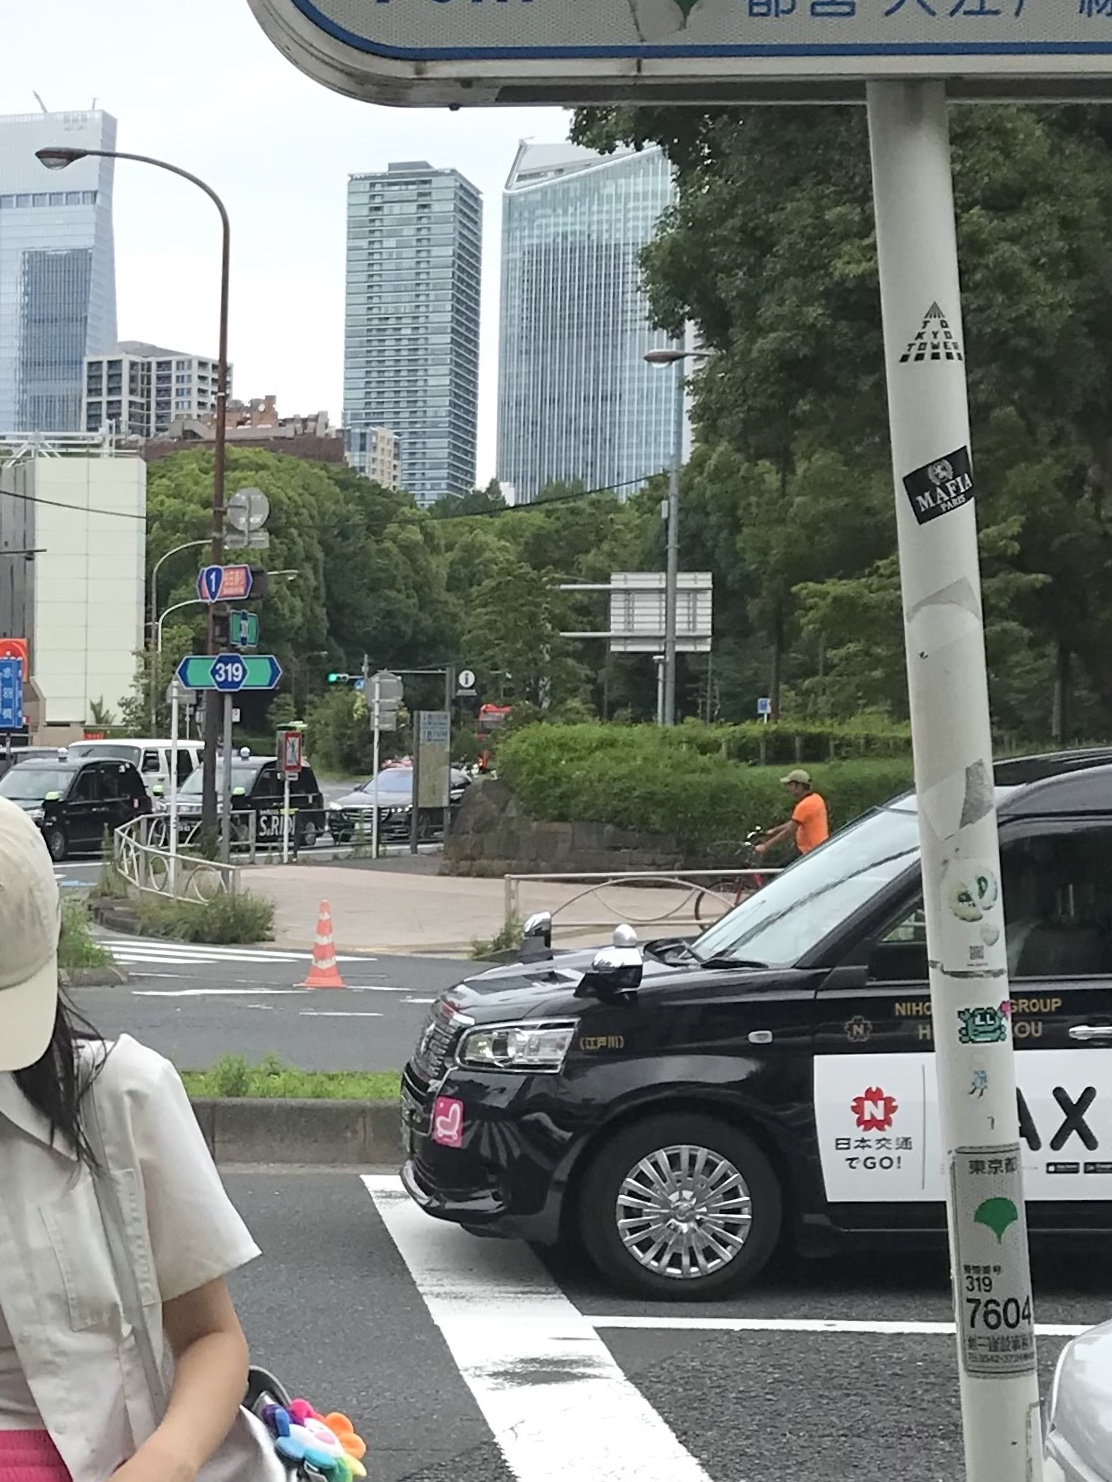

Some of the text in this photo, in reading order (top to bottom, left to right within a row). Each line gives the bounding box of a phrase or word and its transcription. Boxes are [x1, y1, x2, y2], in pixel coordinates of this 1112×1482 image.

[916, 473, 973, 512] MAFIA
[940, 494, 966, 512] PARIS
[209, 571, 216, 592] 1
[215, 663, 243, 682] 319
[835, 1137, 913, 1151] 日本交通
[845, 1156, 902, 1170] でGO!
[968, 1156, 1019, 1175] 東京都
[965, 1275, 993, 1293] 319
[966, 1295, 1032, 1330] 7604
